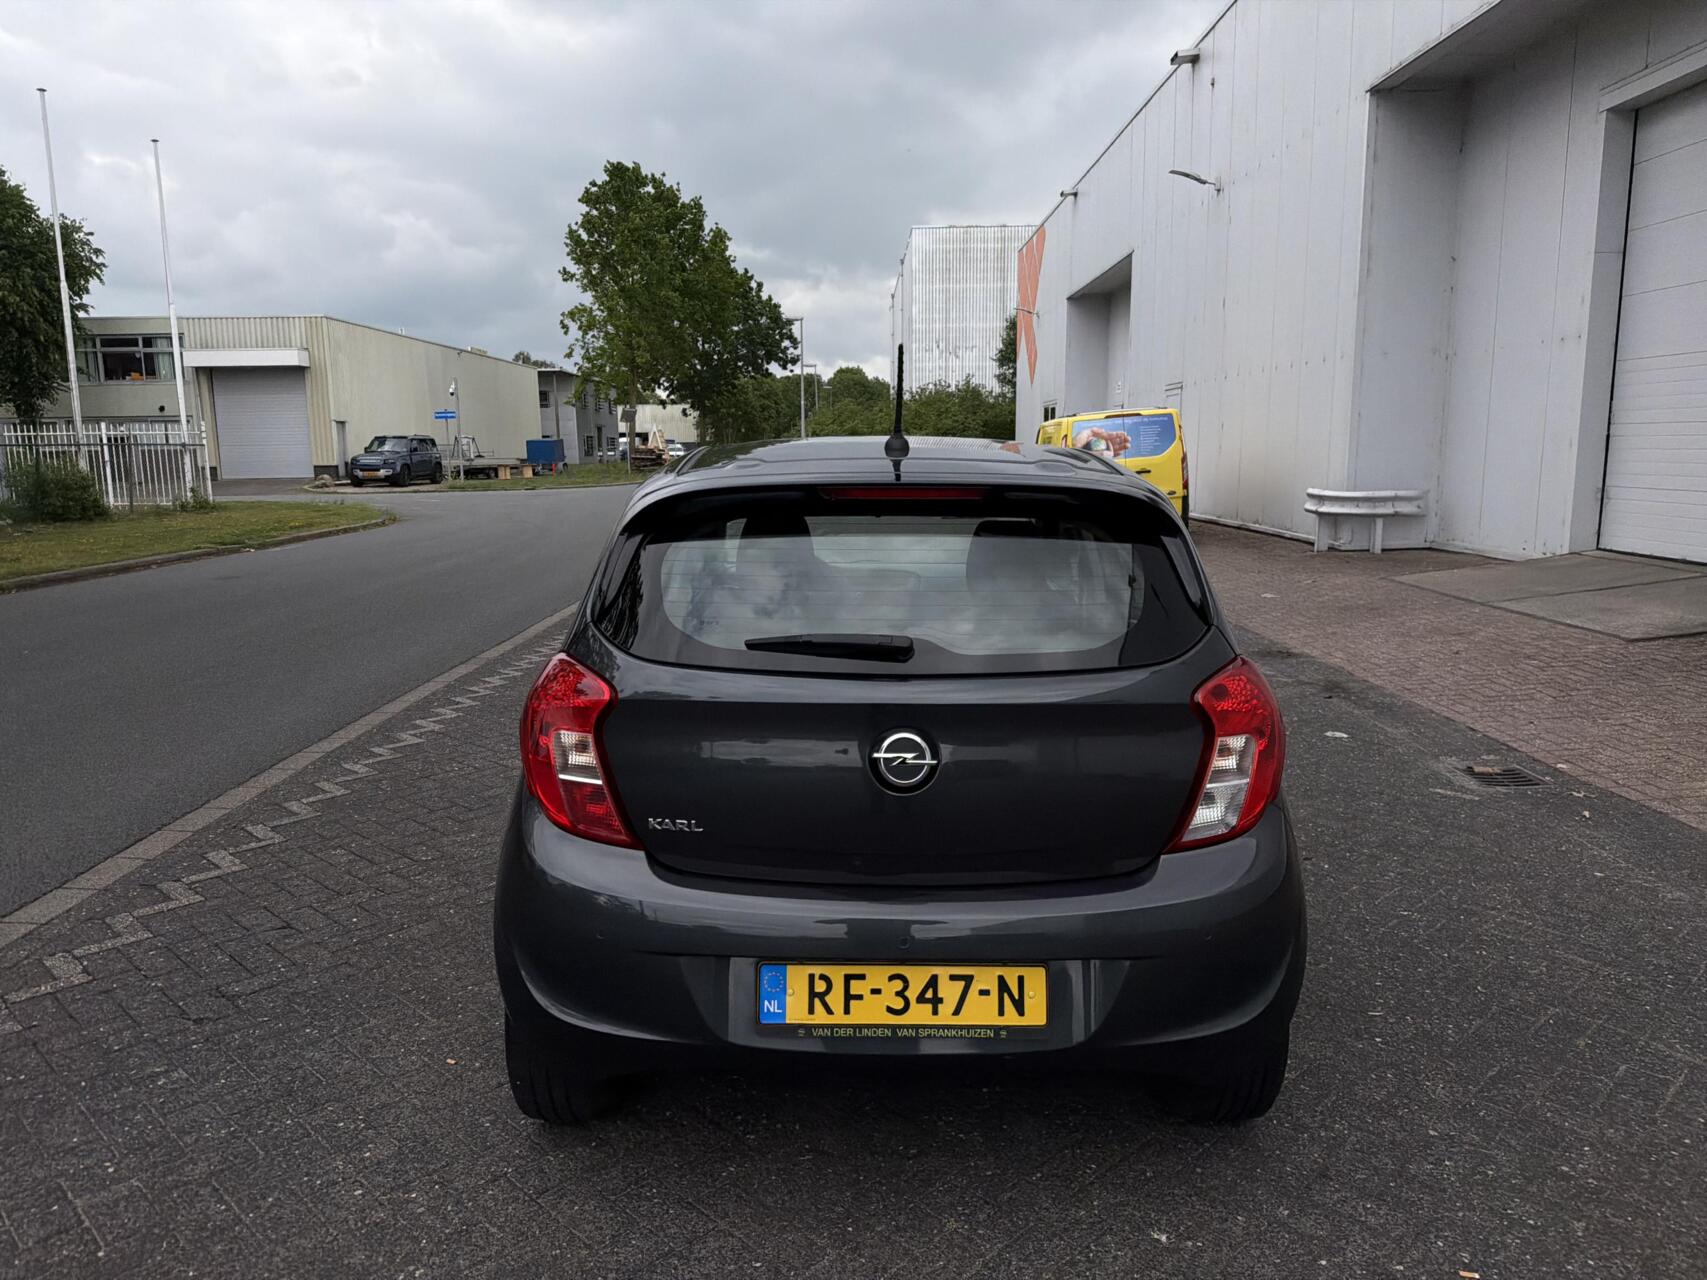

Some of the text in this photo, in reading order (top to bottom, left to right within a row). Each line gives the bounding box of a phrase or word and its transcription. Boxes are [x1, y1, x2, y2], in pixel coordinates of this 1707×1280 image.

[648, 818, 704, 831] KARL
[807, 973, 1025, 1017] RF-347-N
[763, 1000, 782, 1013] NL
[811, 1027, 994, 1038] VAN DER LINDEN VAN SPRANKHUIZEN
